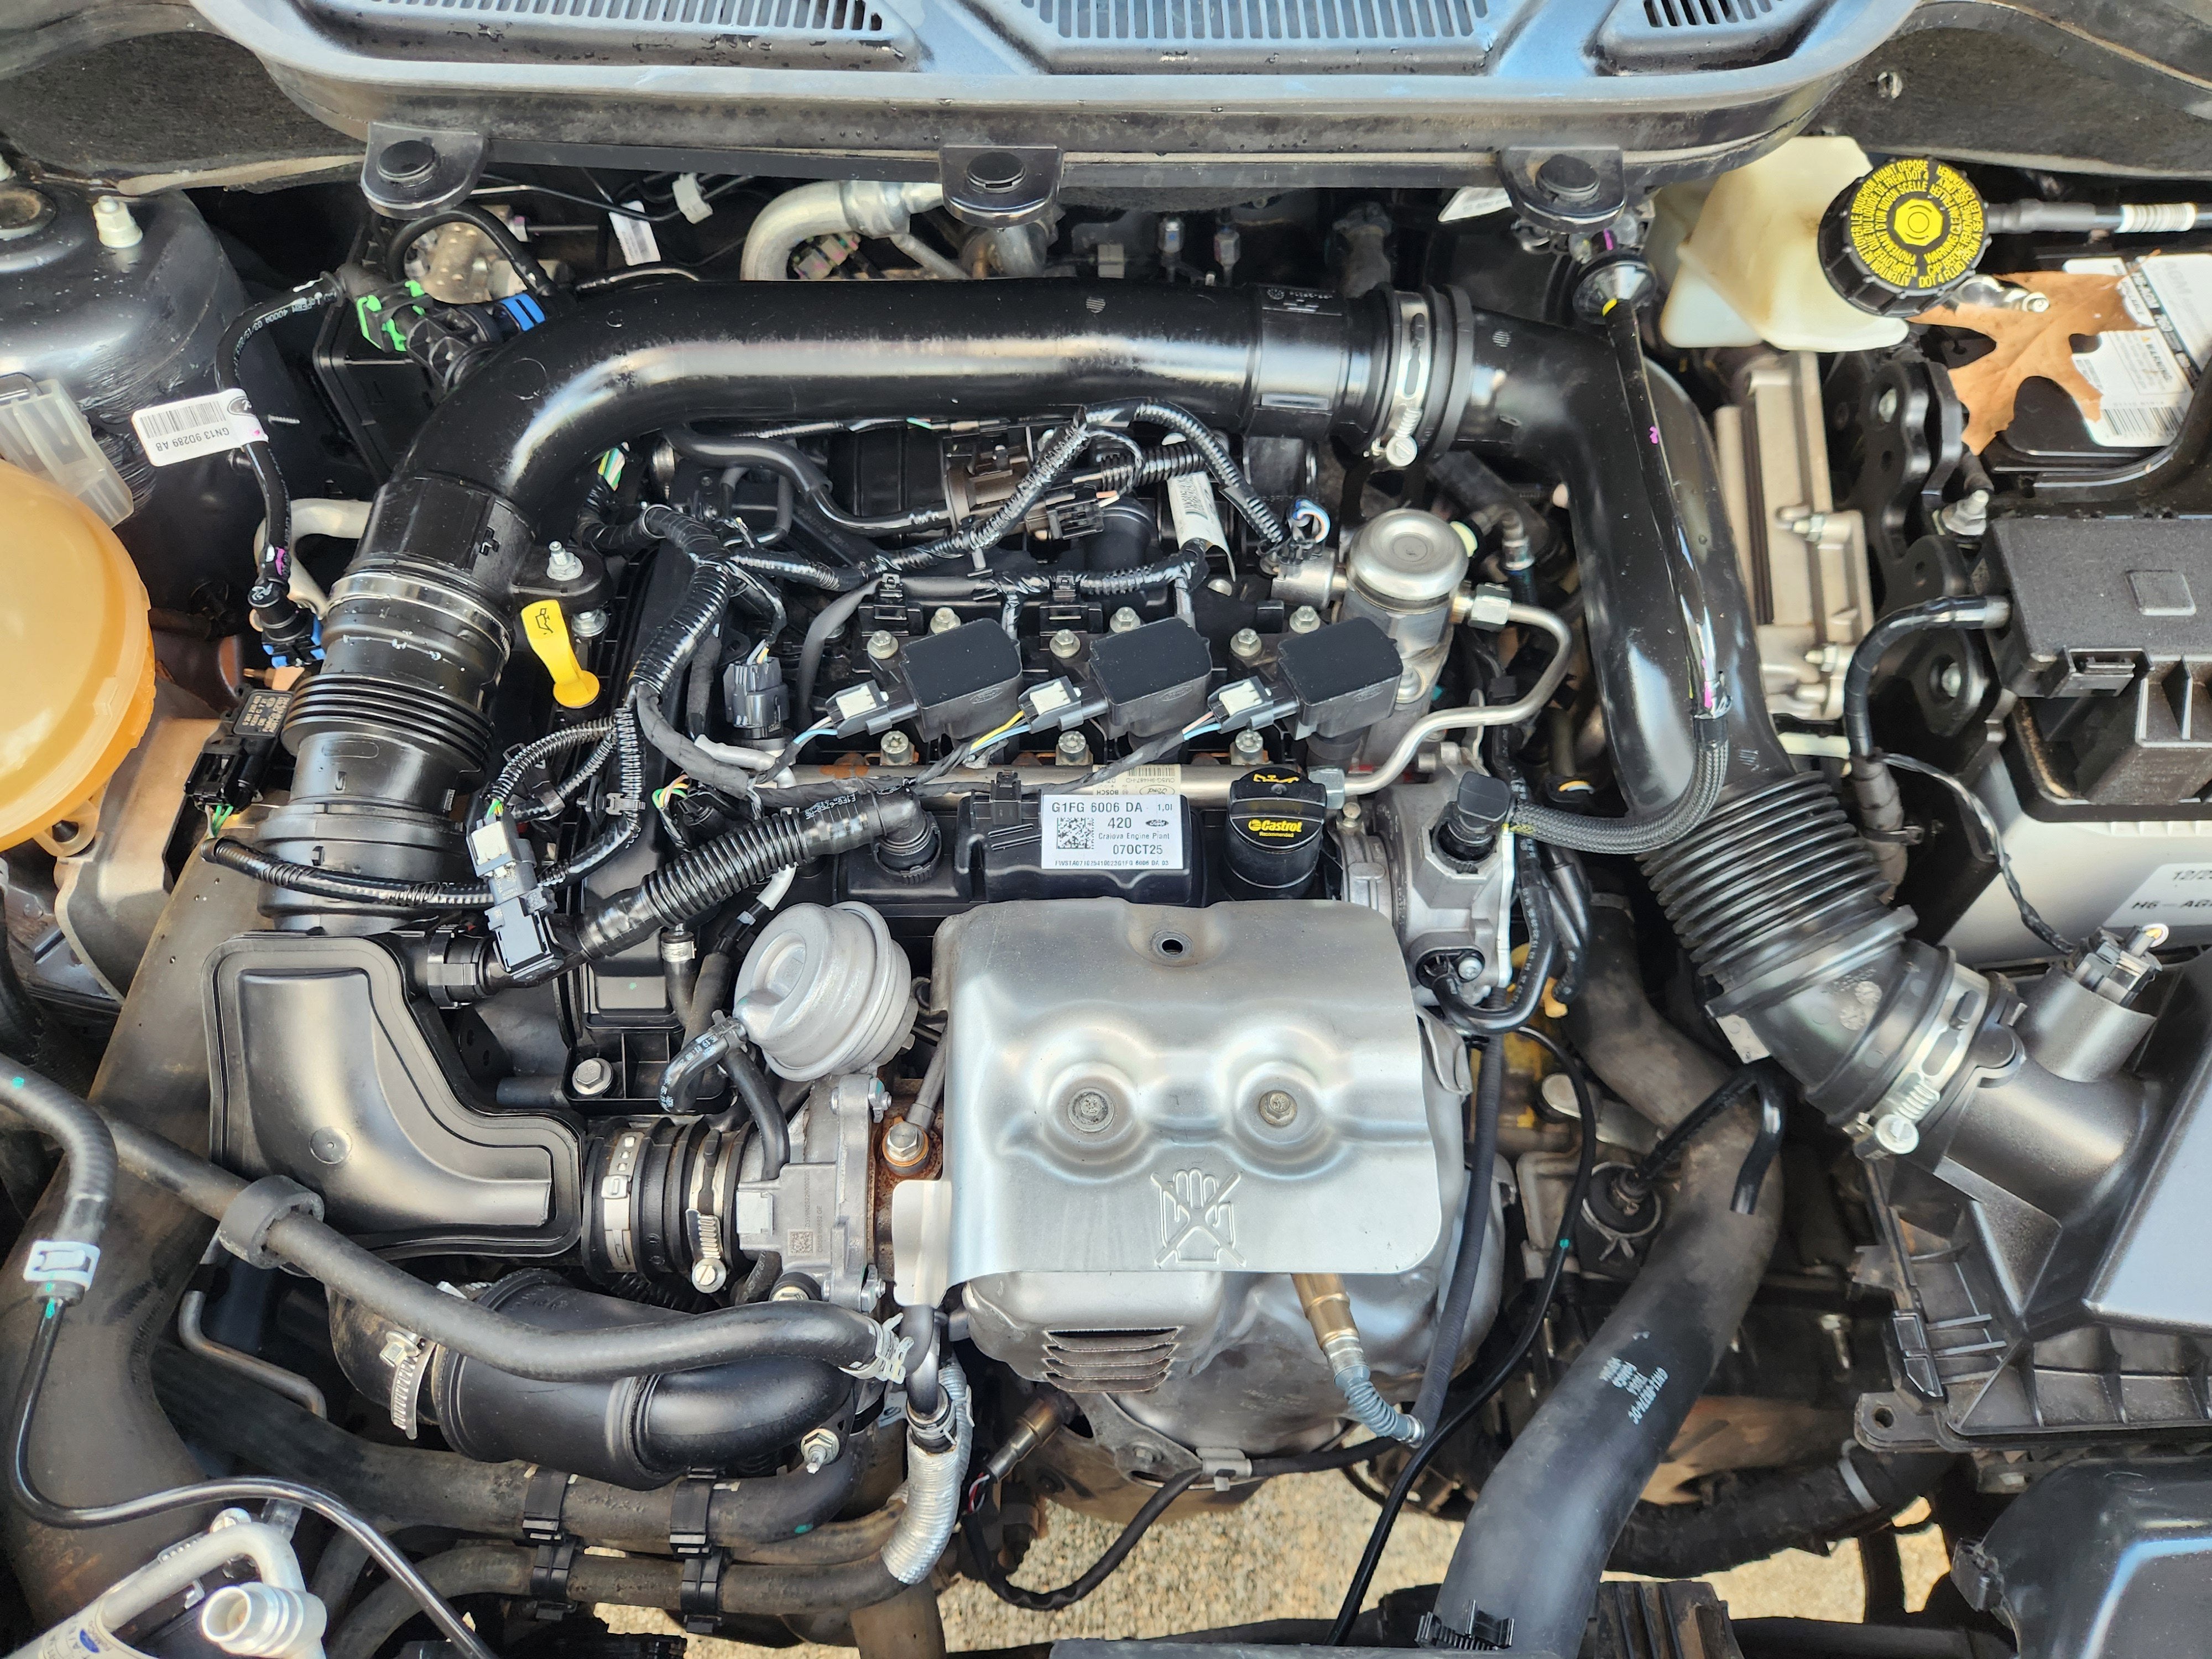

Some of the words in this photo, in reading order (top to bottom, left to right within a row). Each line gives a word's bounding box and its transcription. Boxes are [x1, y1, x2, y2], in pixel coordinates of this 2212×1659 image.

[1872, 164, 1898, 185] AVANT
[1896, 159, 1928, 174] DEPOSE
[1906, 169, 1922, 181] DOT
[1874, 182, 1888, 196] DE
[1882, 170, 1907, 190] FREIN
[1936, 175, 1958, 195] ONLY
[1937, 164, 1976, 202] CONTAINER
[1851, 178, 1877, 215] BOUCHON
[1877, 187, 1900, 211] BIDON
[1896, 180, 1928, 195] SCELLE
[1929, 183, 1957, 208] FILLER
[1952, 189, 1968, 207] USE
[1863, 191, 1881, 221] LIQUIDE
[1850, 215, 1863, 225] LE
[1949, 205, 1962, 236] CLEAN
[1969, 199, 1984, 233] SEALED
[1863, 222, 1875, 234] DU
[1864, 233, 1881, 252] QUE
[1923, 233, 1959, 265] WARNING
[1960, 238, 1981, 264] FROM
[1941, 242, 1968, 270] BEFORE
[1926, 261, 1945, 276] CAP
[1943, 259, 1967, 280] FLUID
[1918, 273, 1937, 288] DOT
[173, 432, 202, 447] 9D289
[206, 427, 230, 440] GN13
[155, 441, 169, 452] AB
[1052, 802, 1084, 812] G1FG
[1091, 802, 1120, 812] 6006
[1126, 802, 1142, 812] DA
[1108, 817, 1132, 828] 420
[1261, 818, 1302, 833] Castrol
[816, 1204, 823, 1214] GE
